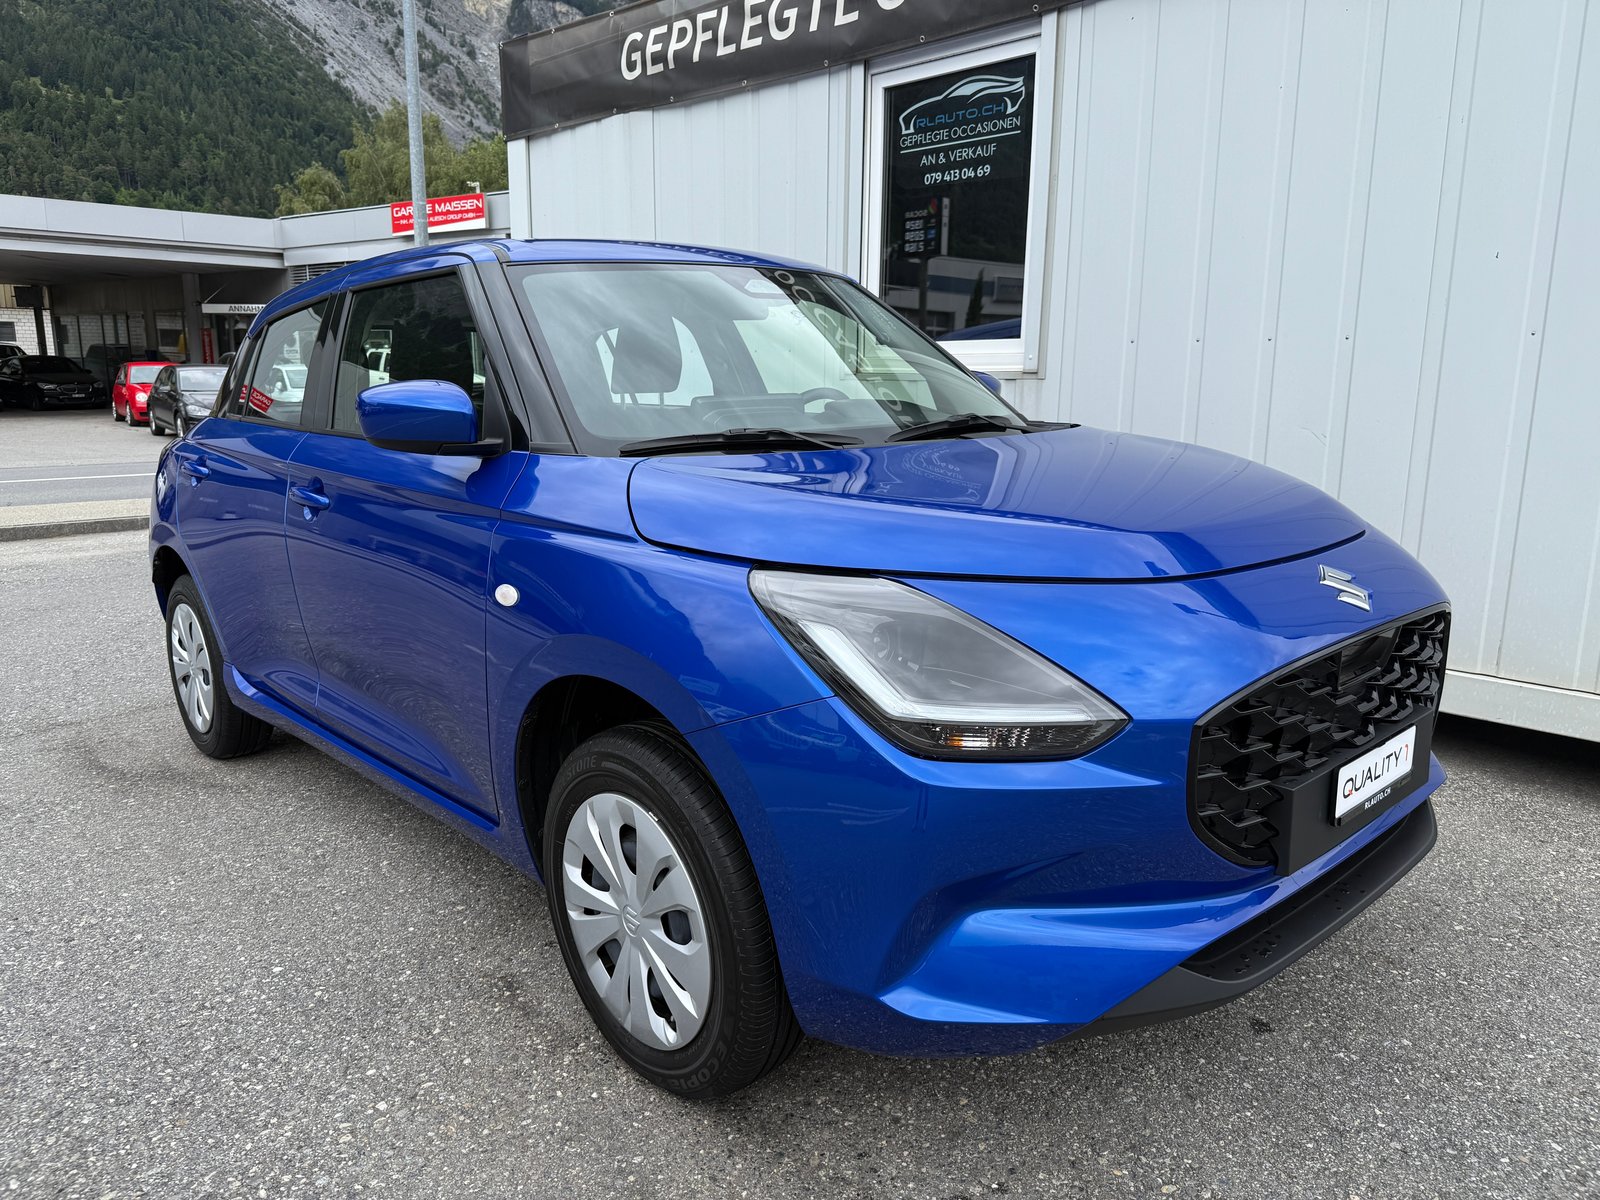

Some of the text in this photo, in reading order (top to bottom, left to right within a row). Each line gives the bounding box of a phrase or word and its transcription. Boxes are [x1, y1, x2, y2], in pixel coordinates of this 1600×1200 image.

[915, 103, 1004, 129] RLAUTO.CH
[900, 116, 1021, 148] GEPFLEGTE OCCASIONEN
[920, 143, 997, 167] AN & VERKAUF
[924, 164, 991, 185] 079 413 04 69
[393, 198, 483, 217] GARE MAISSEN
[1342, 746, 1403, 799] QUALITY
[1364, 786, 1392, 810] RLAUTO.CH
